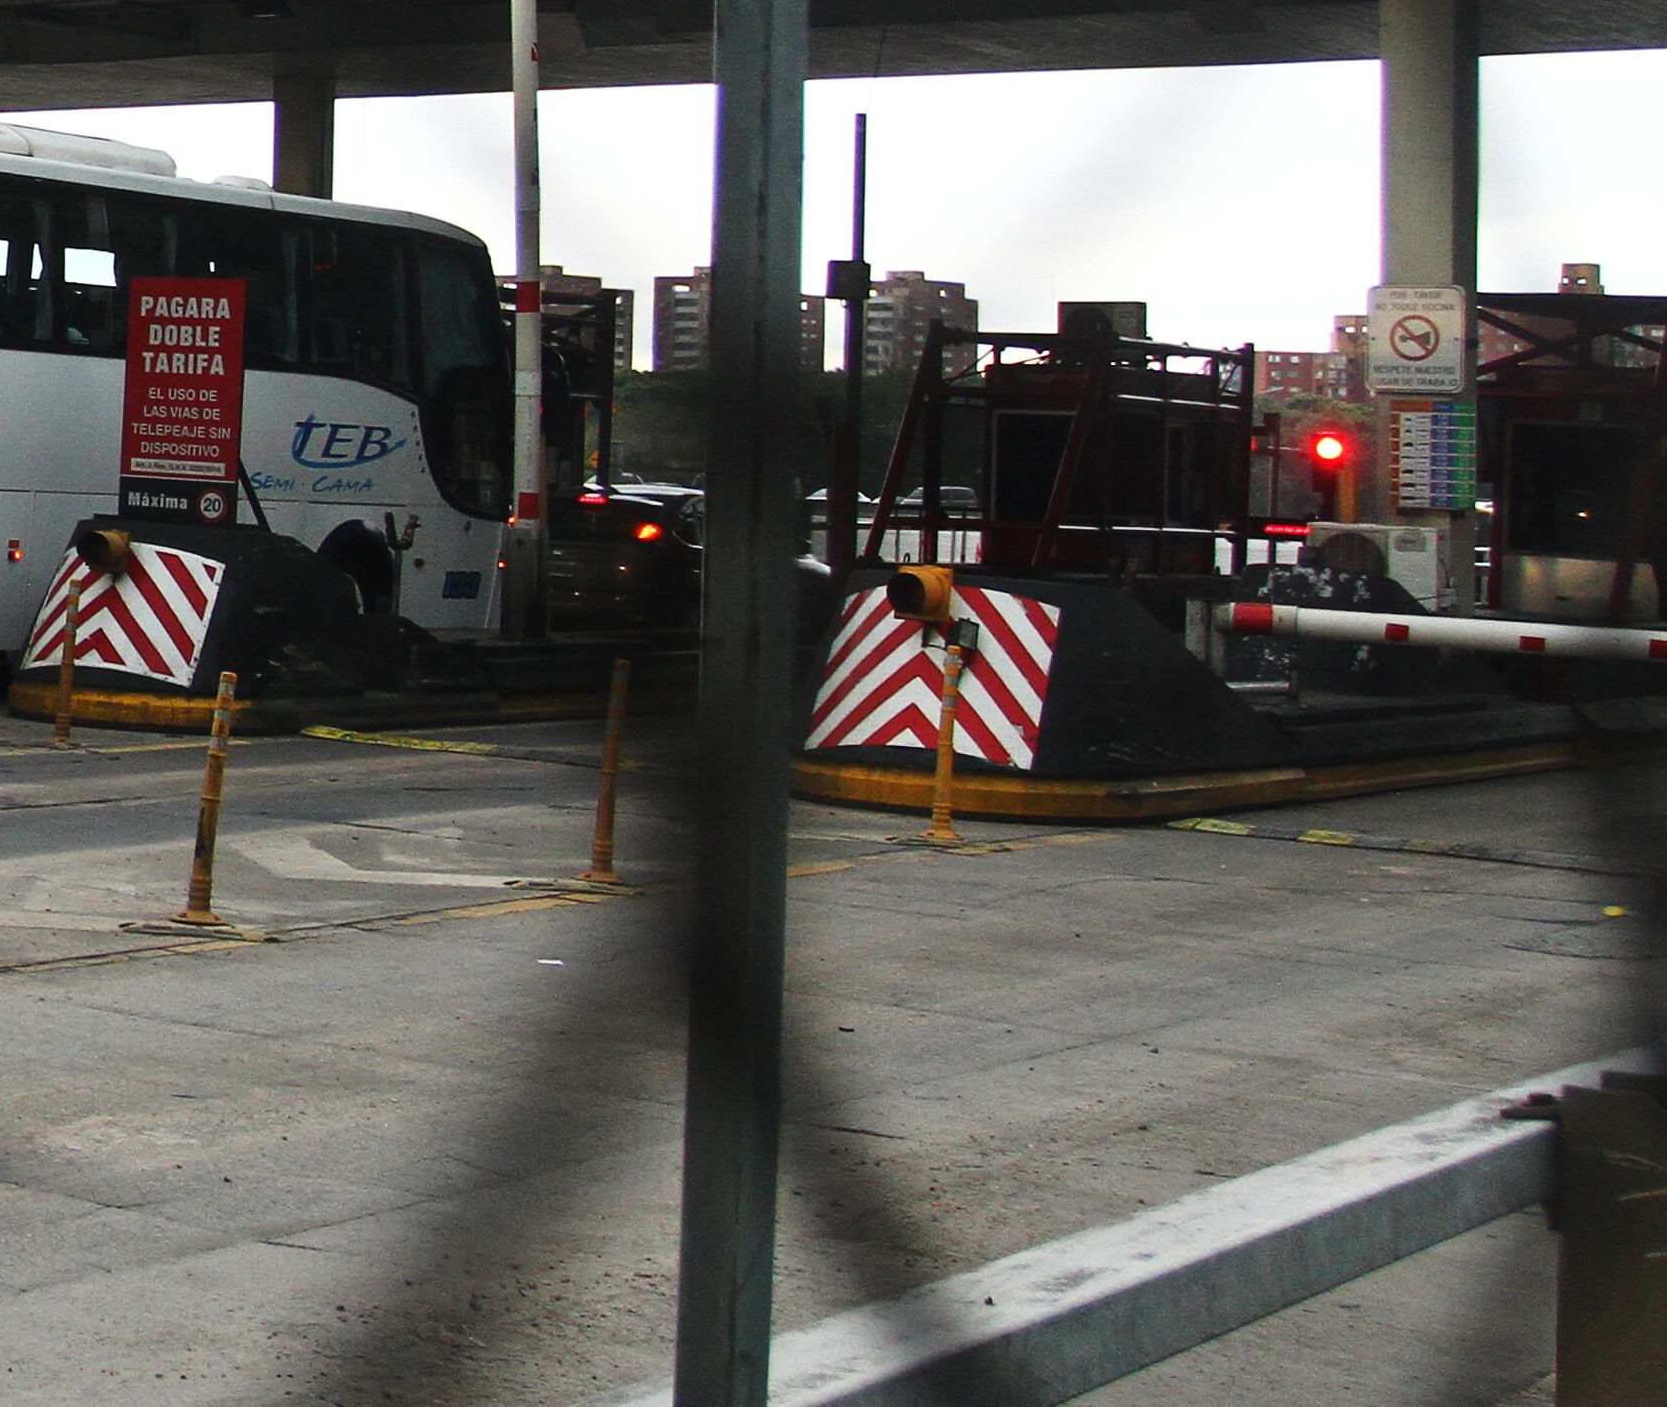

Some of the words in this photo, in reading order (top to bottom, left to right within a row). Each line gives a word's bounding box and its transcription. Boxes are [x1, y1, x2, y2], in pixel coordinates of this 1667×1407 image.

[141, 296, 231, 319] PAGARA
[149, 324, 221, 347] DOBLE
[142, 352, 224, 375] TARIFA
[149, 387, 164, 399] EL
[168, 388, 196, 400] USO
[200, 390, 217, 402] DE
[143, 405, 167, 418] LAS
[170, 406, 199, 419] VIAS
[203, 408, 221, 420] DE
[131, 422, 206, 438] TELEPEAJE
[209, 427, 231, 439] SIN
[141, 441, 220, 457] DISPOSITIVO
[312, 475, 373, 493] CAMA
[203, 497, 221, 513] 20
